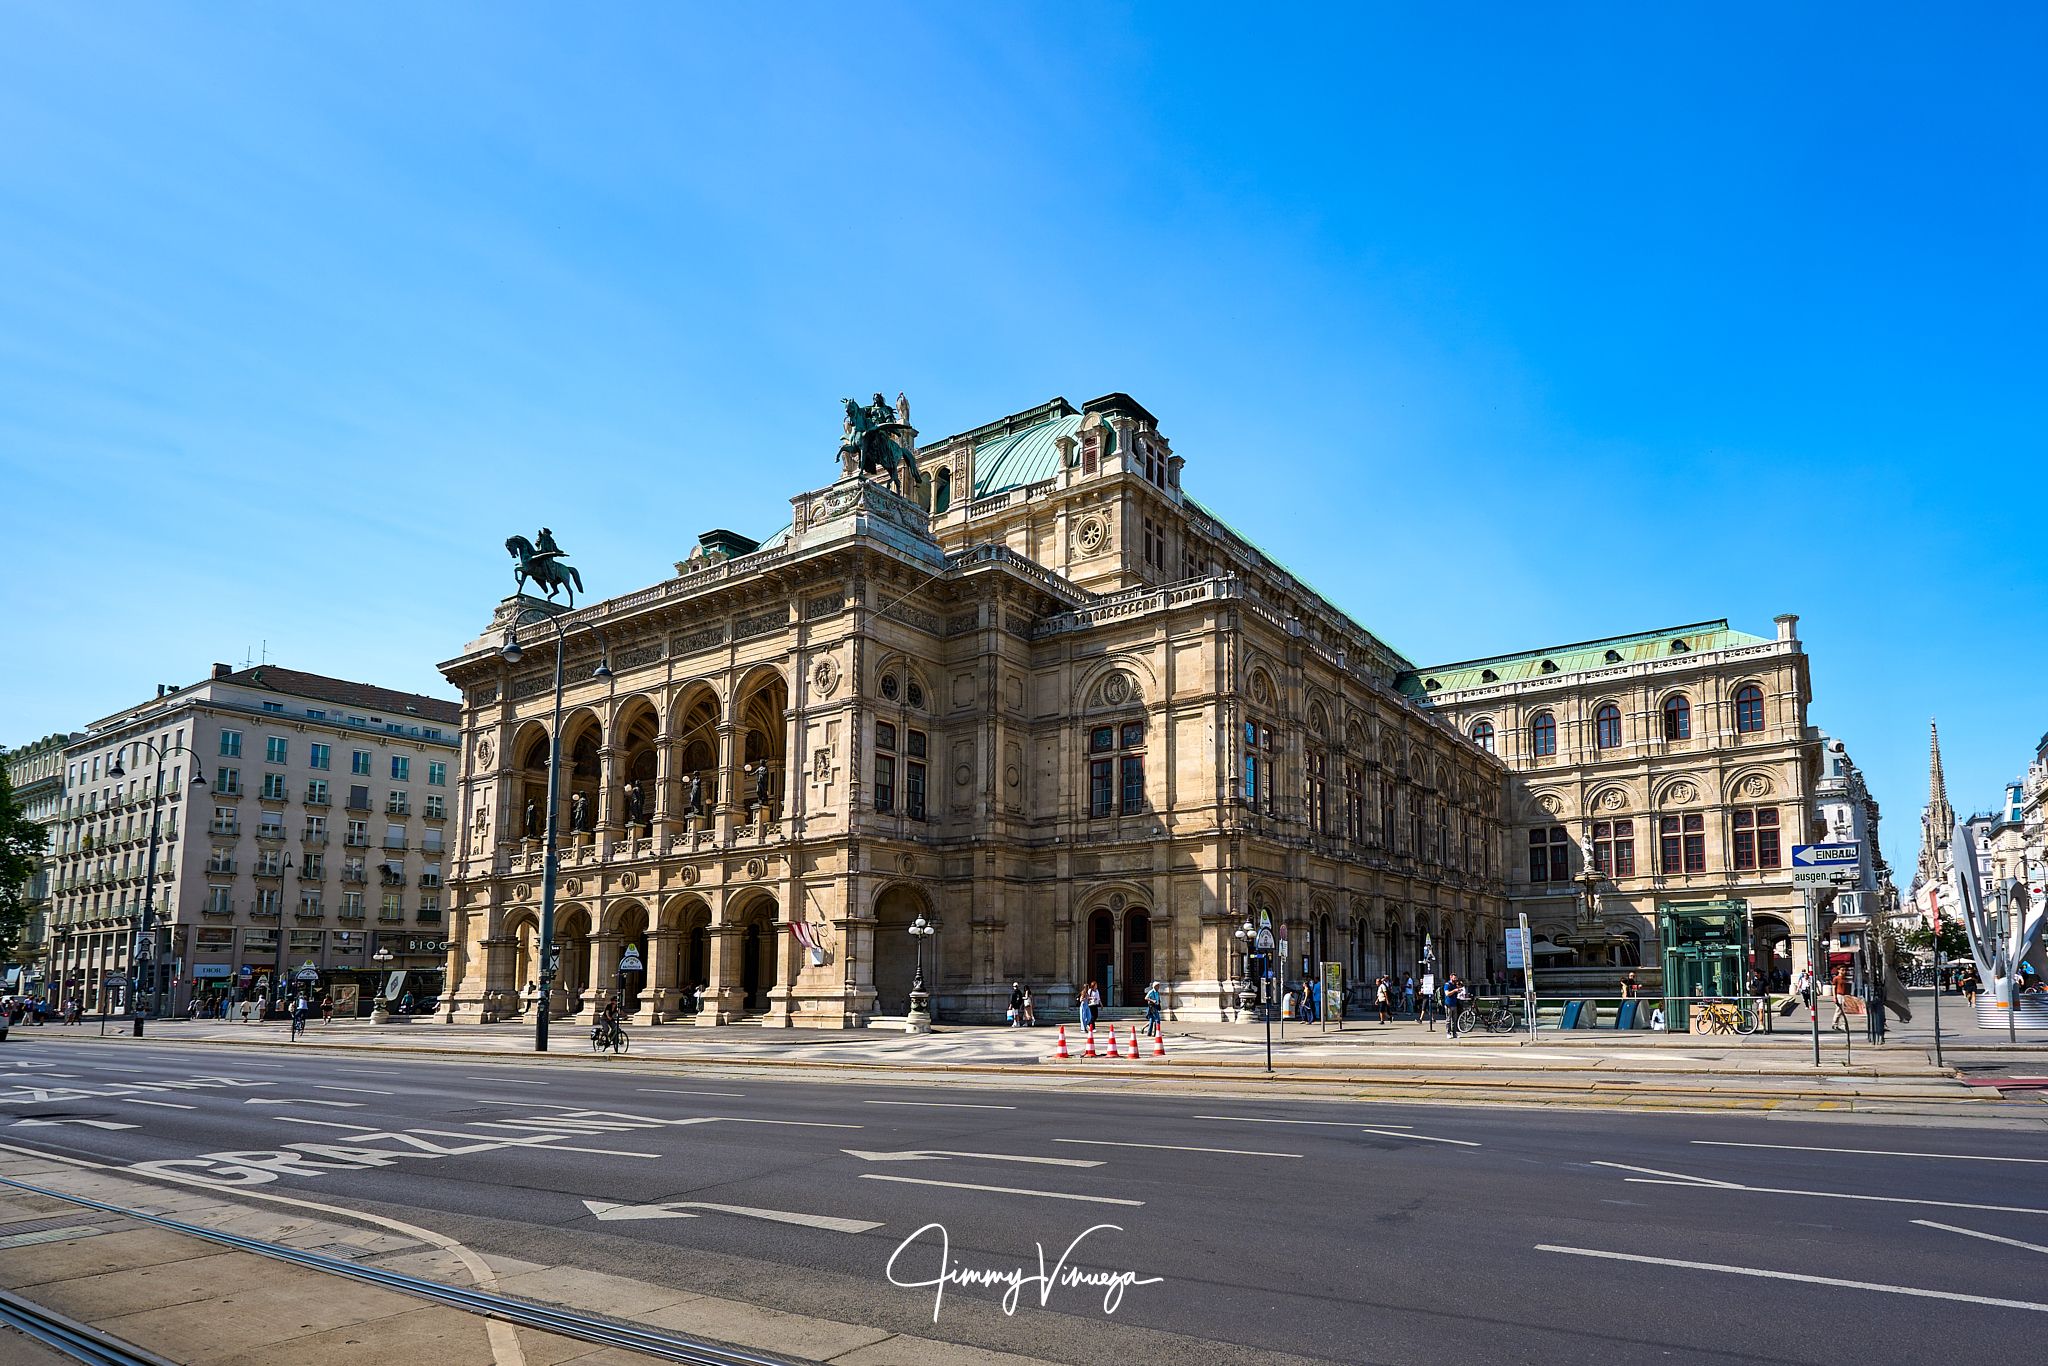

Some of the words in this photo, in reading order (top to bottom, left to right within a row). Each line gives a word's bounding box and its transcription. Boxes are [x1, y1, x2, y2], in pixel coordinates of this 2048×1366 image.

[1795, 872, 1829, 883] ausgen.
[128, 1132, 511, 1186] GRAZ
[404, 1111, 719, 1143] LINZ
